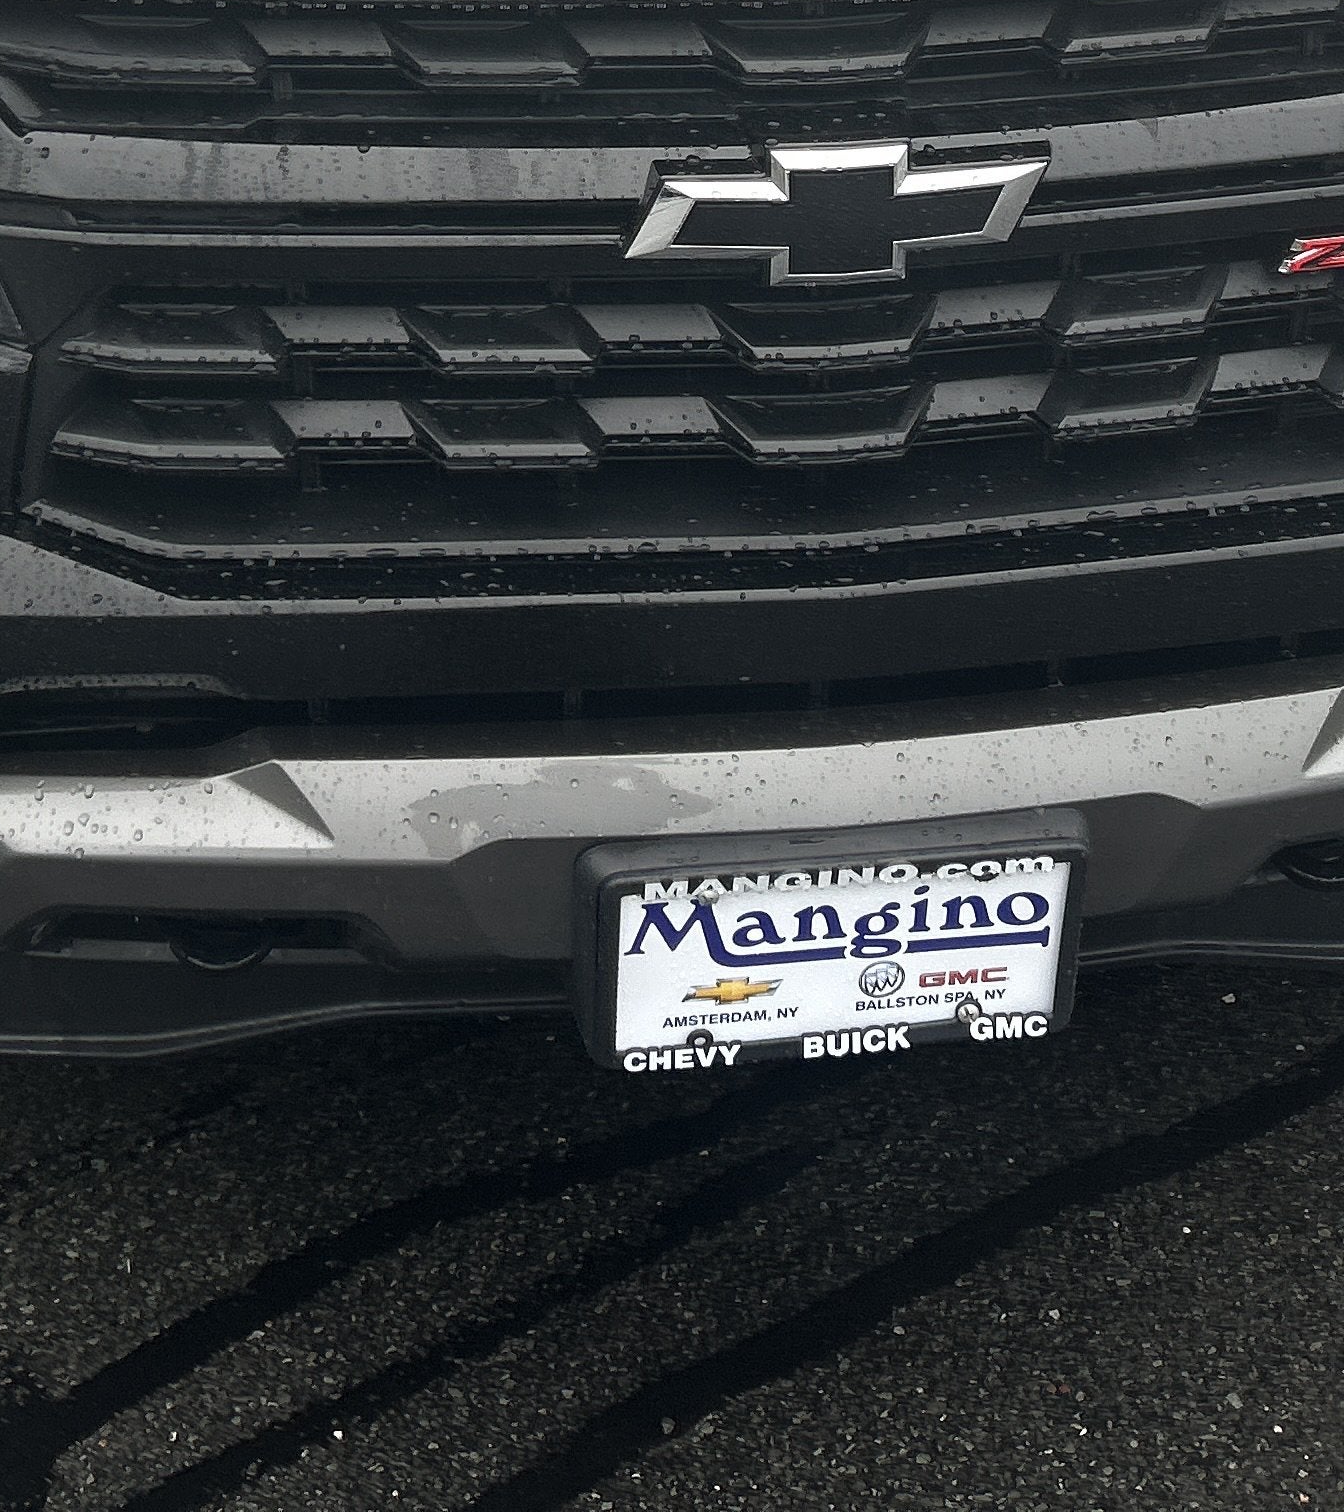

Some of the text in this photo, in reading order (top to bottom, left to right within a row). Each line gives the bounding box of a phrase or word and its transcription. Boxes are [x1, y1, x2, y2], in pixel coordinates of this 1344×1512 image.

[623, 885, 1051, 968] Mangino
[918, 966, 1009, 988] GMC
[855, 994, 940, 1012] BALLSTON
[984, 988, 1007, 1001] NY
[662, 1006, 800, 1029] AMSTERDAM, NY
[623, 1014, 1049, 1073] CHEVY BUICK GMC
